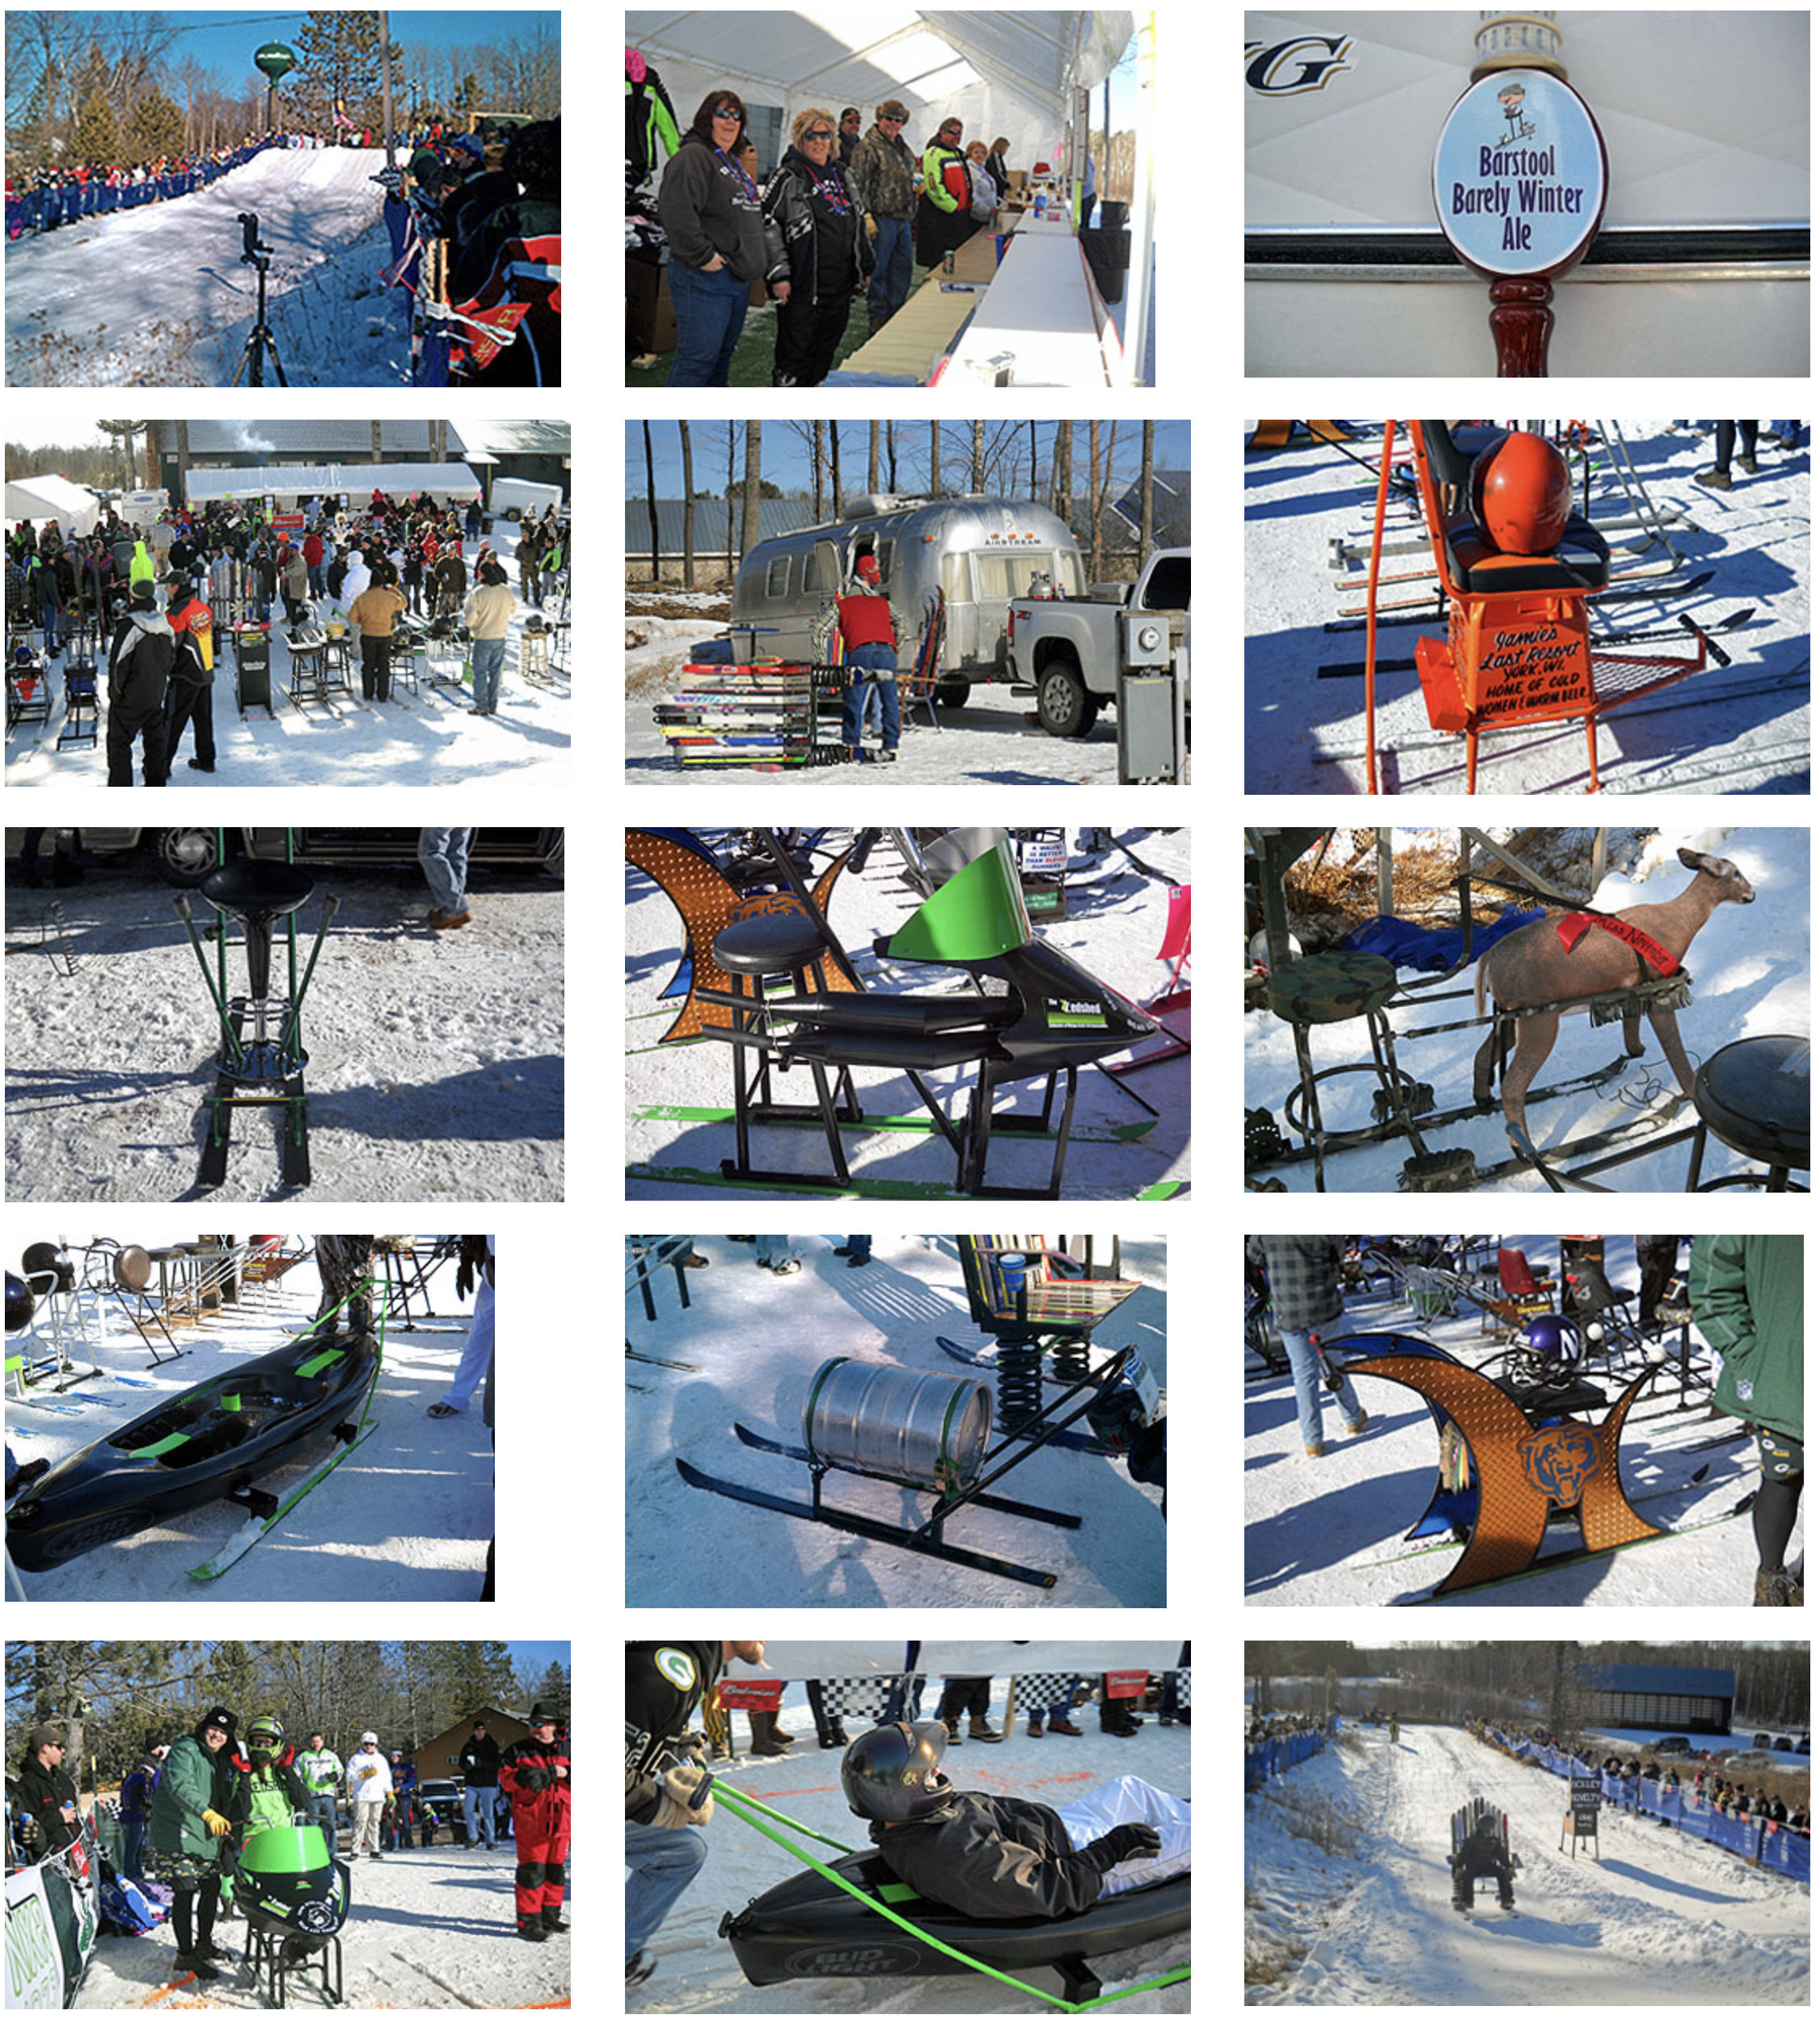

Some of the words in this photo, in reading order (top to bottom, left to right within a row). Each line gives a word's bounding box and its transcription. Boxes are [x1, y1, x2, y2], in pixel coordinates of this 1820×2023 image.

[1244, 34, 1353, 97] G
[1479, 144, 1555, 177] Barstool
[1452, 179, 1511, 218] Barely
[1517, 179, 1584, 213] Winter
[1501, 216, 1531, 251] Ale
[1494, 623, 1557, 652] Jamie's
[1477, 649, 1524, 672] Last
[1525, 640, 1581, 663] Resort
[1485, 681, 1524, 699] HOME
[1527, 678, 1544, 691] OF
[1548, 672, 1581, 688] COLD
[1476, 697, 1517, 718] WOMEN
[1559, 1328, 1579, 1361] N
[804, 1958, 897, 1974] LIGHT
[814, 1949, 885, 1964] BUD
